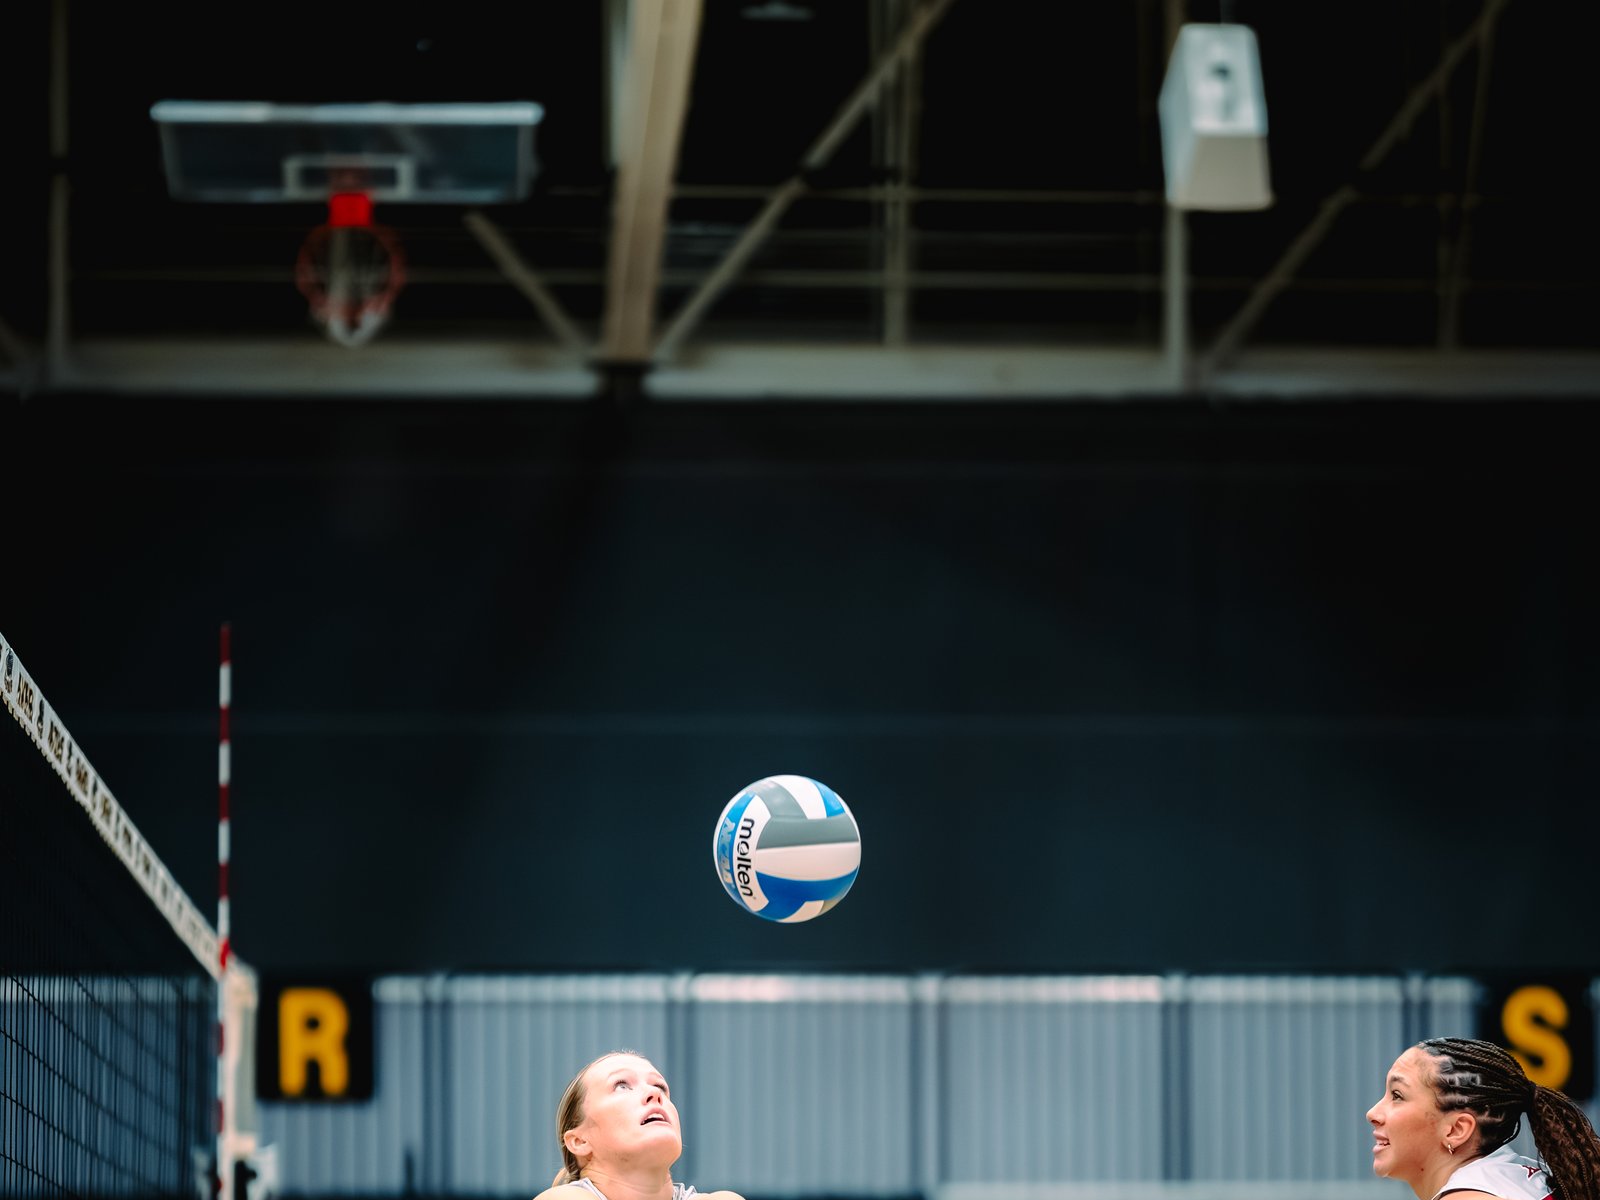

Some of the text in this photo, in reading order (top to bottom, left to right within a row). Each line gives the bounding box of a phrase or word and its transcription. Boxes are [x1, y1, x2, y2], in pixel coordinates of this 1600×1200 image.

[737, 817, 755, 897] molten
[278, 986, 350, 1098] R
[1502, 984, 1571, 1090] S
